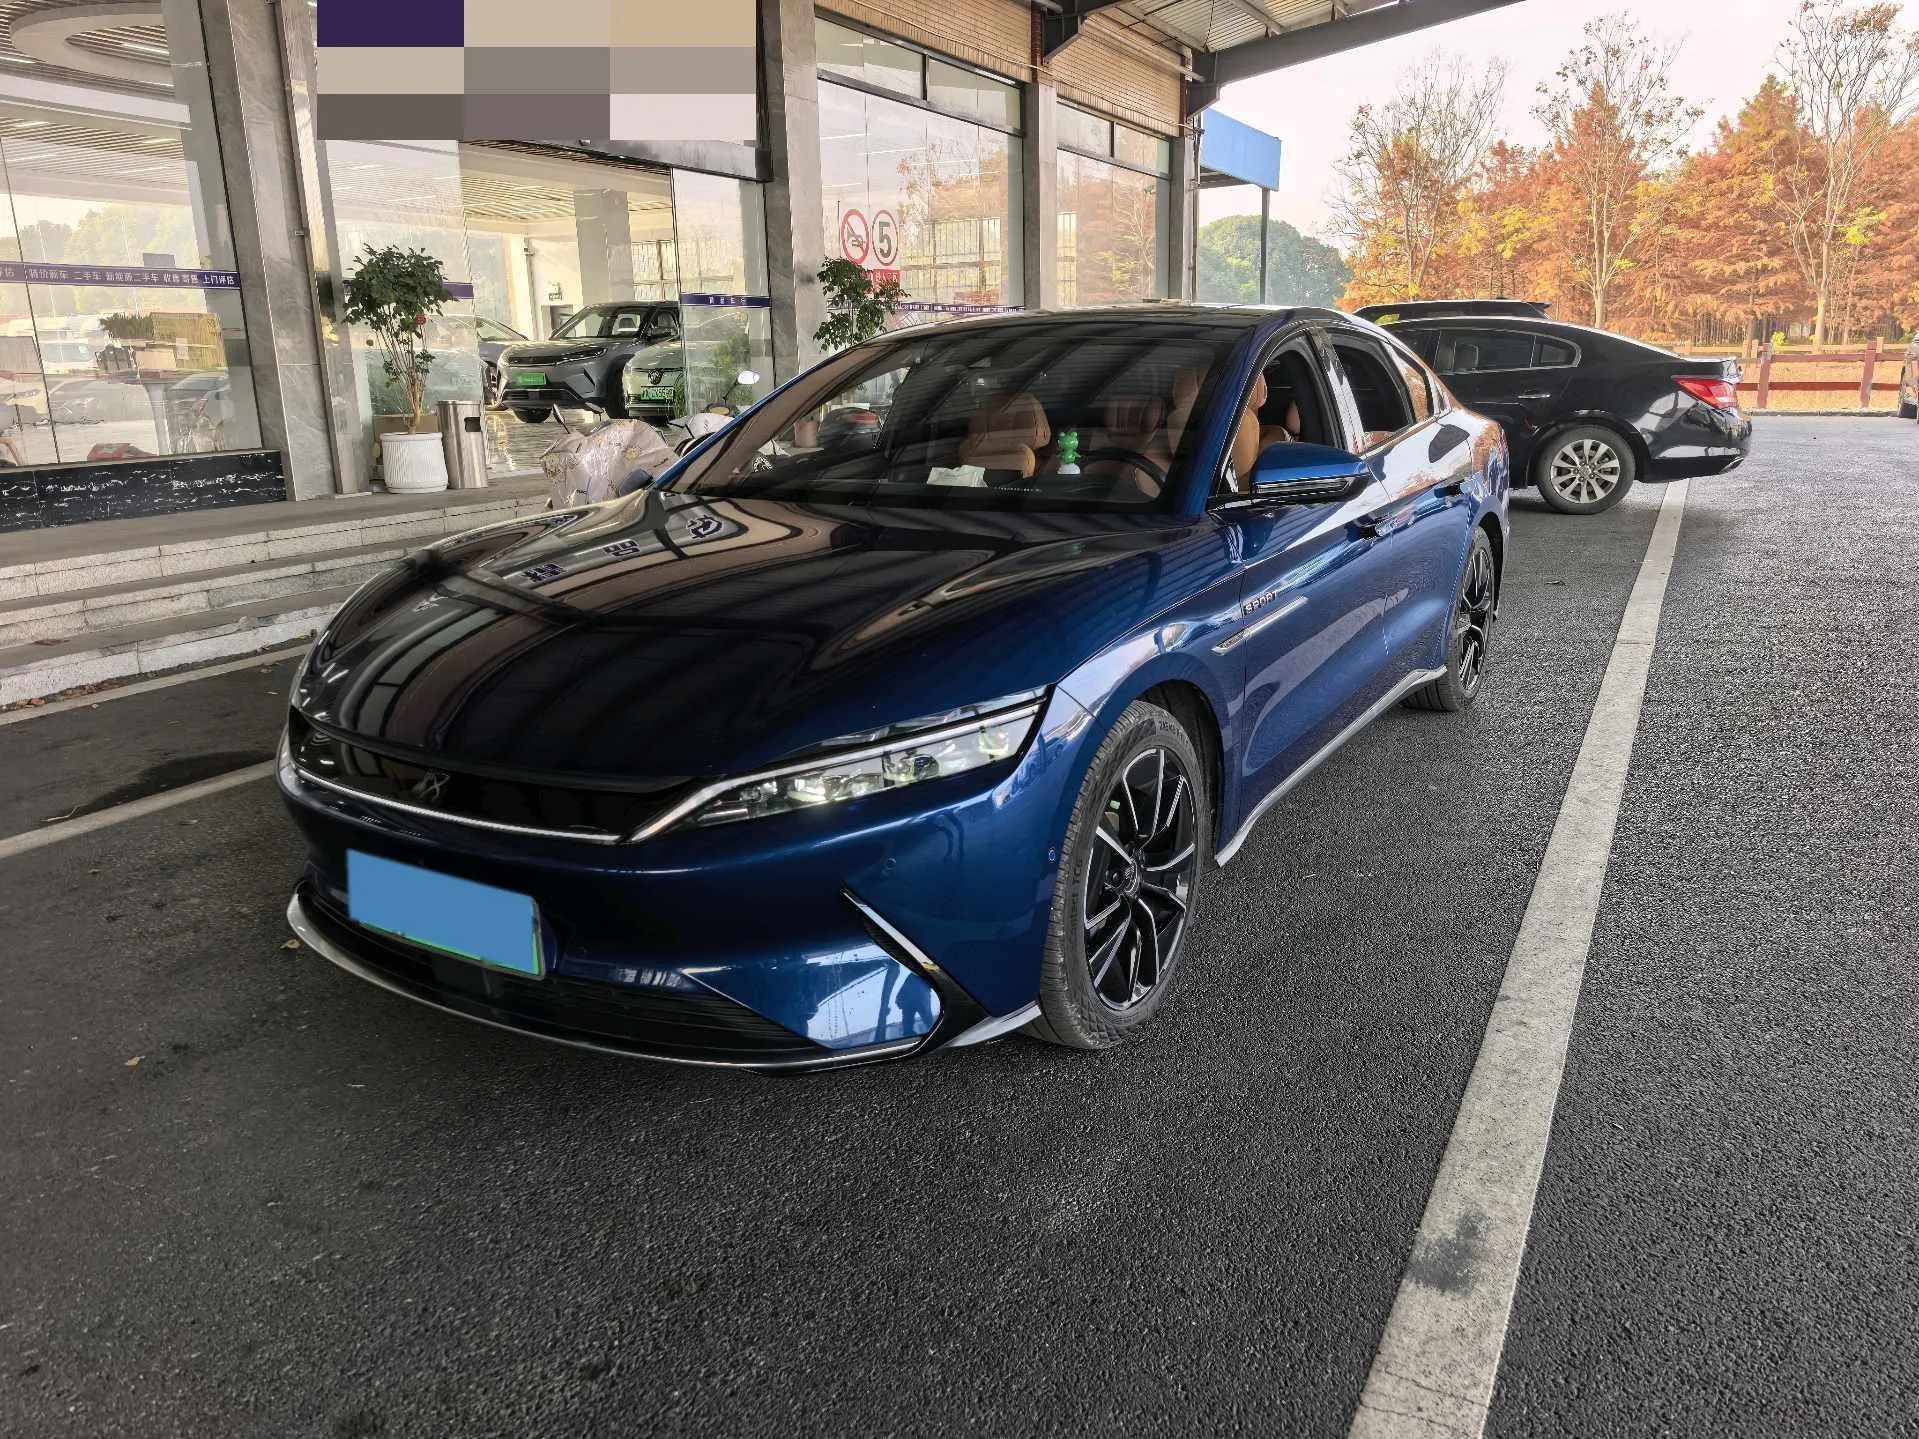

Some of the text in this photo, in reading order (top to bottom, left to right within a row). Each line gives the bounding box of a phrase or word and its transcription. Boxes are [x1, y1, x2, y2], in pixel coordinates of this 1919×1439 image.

[878, 221, 892, 259] 5
[203, 274, 235, 286] 上门评估
